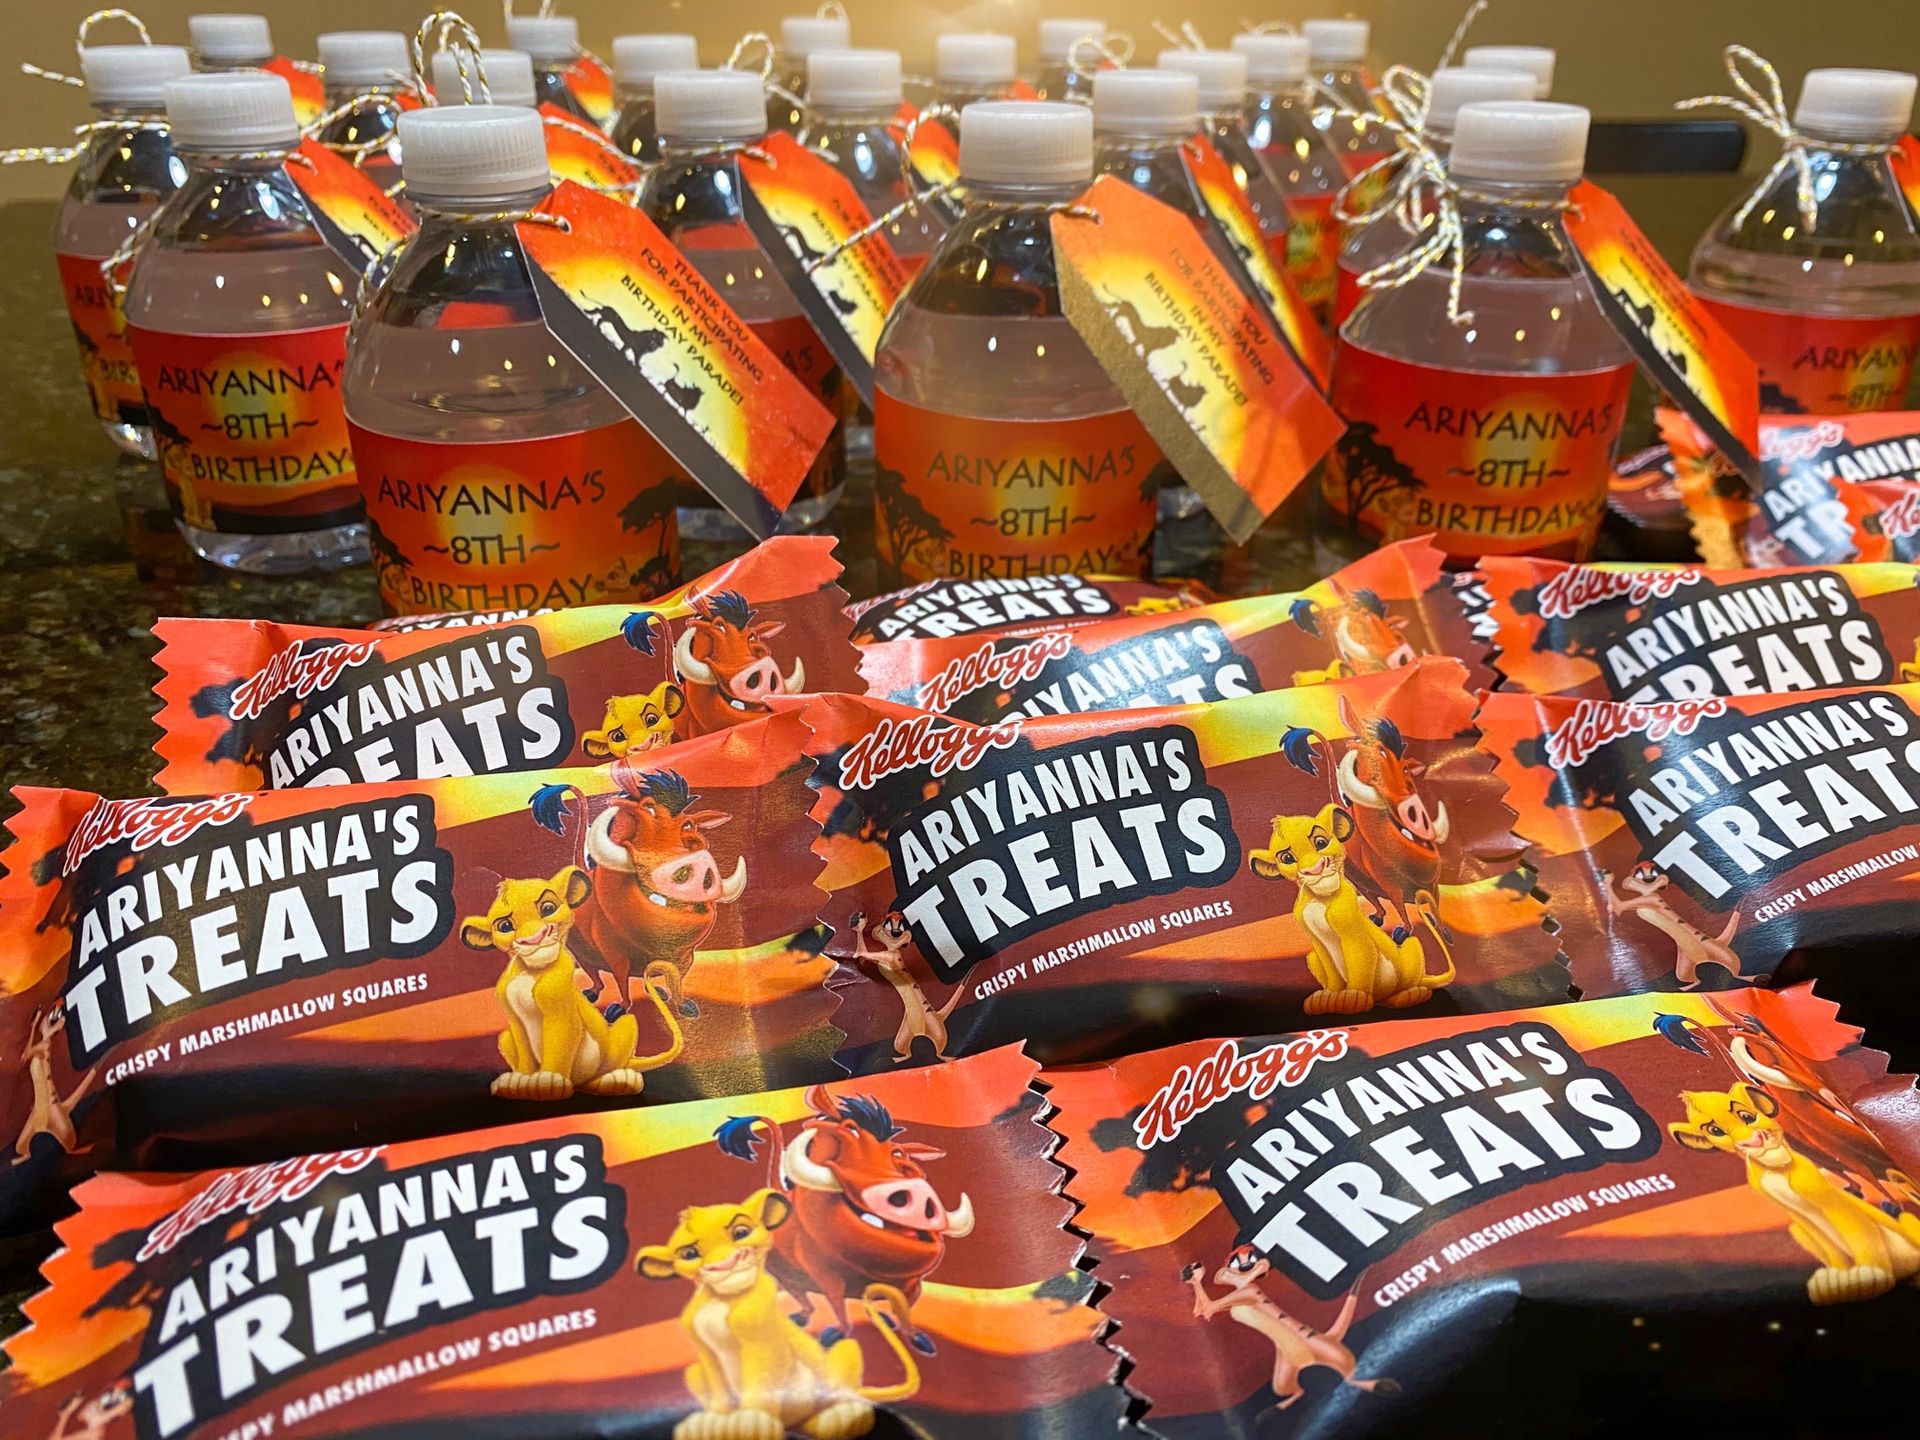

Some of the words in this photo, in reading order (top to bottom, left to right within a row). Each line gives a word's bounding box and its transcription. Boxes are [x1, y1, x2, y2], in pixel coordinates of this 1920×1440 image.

[674, 258, 720, 314] THANK
[721, 310, 749, 343] YOU
[1169, 247, 1194, 280] FOR
[1201, 262, 1242, 314] THANK
[1241, 313, 1269, 346] YOU
[620, 274, 688, 344] BIRTHDAY
[641, 248, 668, 280] FOR
[669, 279, 764, 382] PARTICIPATING
[671, 305, 690, 324] IN
[689, 325, 713, 347] MY
[1144, 271, 1199, 343] BIRTHDAY
[1189, 305, 1208, 326] IN
[1205, 326, 1228, 347] MY
[158, 359, 344, 397] ARIYANNA'
[190, 447, 349, 482] BIRTHDAY
[377, 469, 606, 516] ARIYANNA'S
[926, 443, 1137, 489] ARIYANNA'S
[1415, 498, 1580, 534] BIRTHDAY
[410, 573, 593, 611] BIRTHDAY
[949, 545, 1114, 579] BIRTHDAY
[1538, 564, 1700, 618] Kelloggs
[877, 573, 1083, 638] ARIYANNA'S
[1605, 576, 1849, 689] ARIYANNA'S
[229, 639, 382, 720] Kelloggs
[915, 633, 1073, 714] Kellogg's
[1626, 619, 1883, 701] REATS
[269, 635, 533, 790] ARIYANNA'S
[303, 687, 561, 788] EATS
[838, 714, 1024, 790] Kelloggs
[1545, 699, 1726, 768] Kelloggs
[1627, 696, 1910, 838] ARIYANNA'S
[62, 793, 254, 877] Kellogg's
[898, 737, 1193, 887] ARIYANNA'S
[78, 805, 420, 969] ARIYANNA'S
[901, 797, 1228, 969] TREATS
[1754, 887, 1807, 923] CRISPY
[1805, 844, 1919, 897] MARSHMALLOW
[64, 860, 439, 1054] TREATS
[973, 960, 1029, 1001] CRISPY
[1032, 918, 1157, 977] MARSHMALLOW
[1158, 898, 1235, 931] SQUARES
[104, 1042, 172, 1087] CRISPY
[179, 992, 337, 1057] MARSHMALLOW
[341, 971, 429, 1008] SQUARES
[1133, 1029, 1349, 1150] Kellogg's
[1225, 1030, 1570, 1214] ARIYANNA'S
[1251, 1077, 1643, 1285] TREATS
[158, 1143, 587, 1345] ARIYANNA'S
[1372, 1255, 1439, 1309] CRISPY
[1439, 1194, 1590, 1265] MARSHMALLOW
[1588, 1172, 1678, 1210] SQUARES
[132, 1195, 610, 1439] TREATS
[282, 1336, 483, 1427] MARSHMALLOW
[488, 1306, 598, 1352] SQUARES
